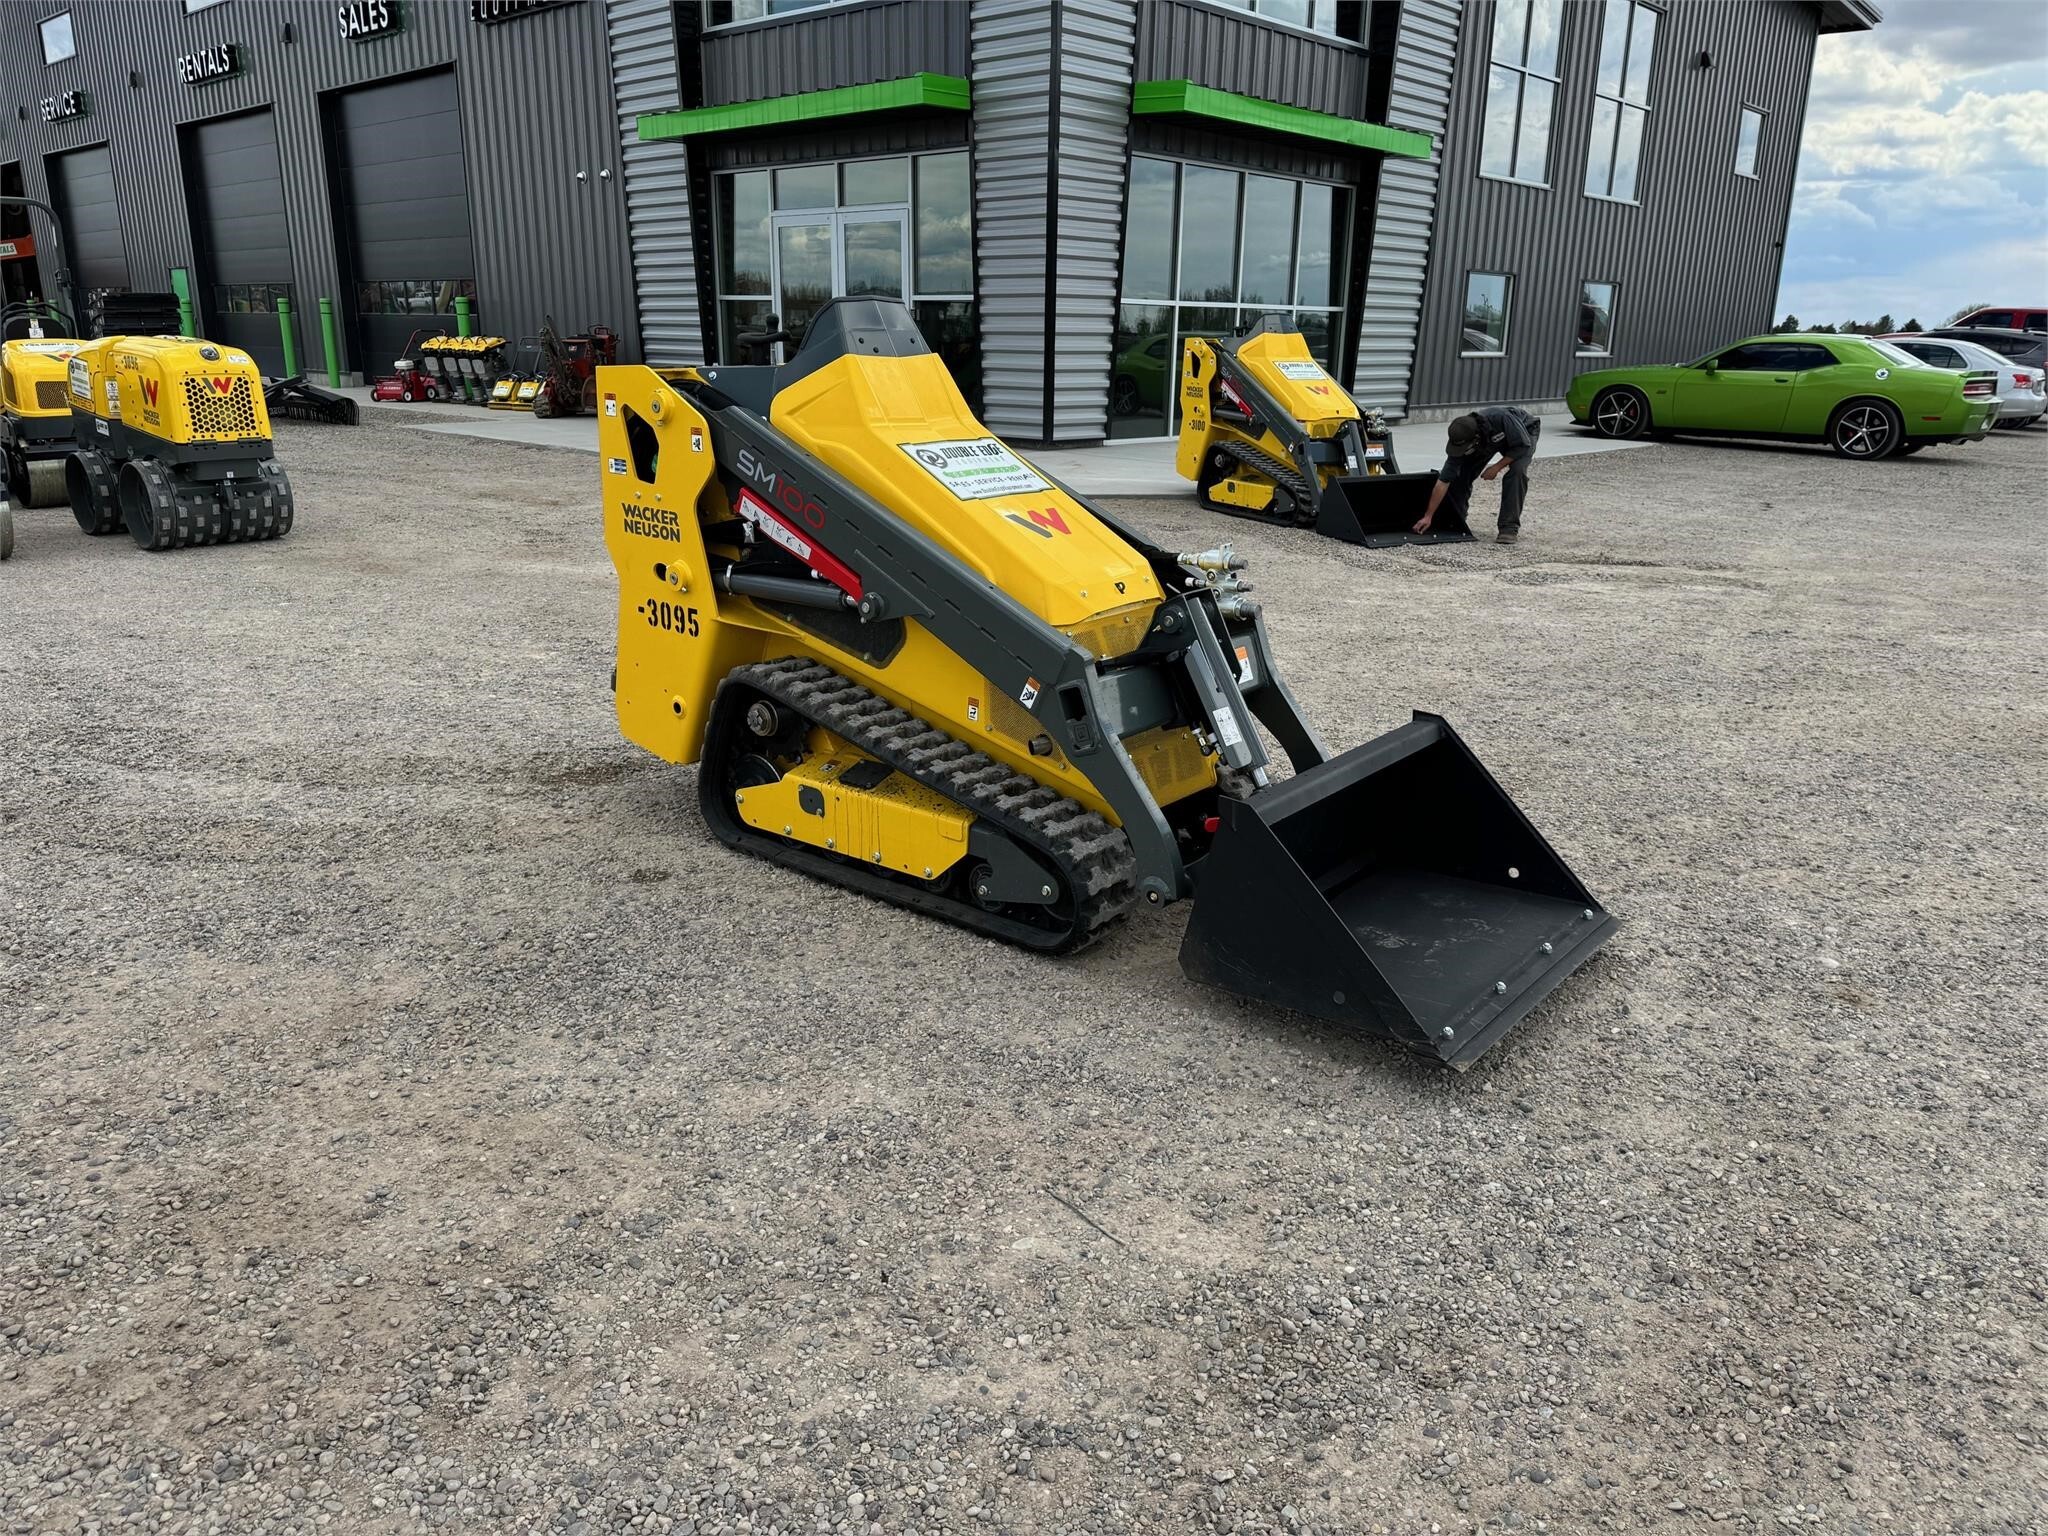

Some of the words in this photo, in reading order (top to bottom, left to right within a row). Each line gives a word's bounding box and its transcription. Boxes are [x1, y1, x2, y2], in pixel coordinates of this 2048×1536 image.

[339, 0, 388, 38] SALES
[178, 43, 230, 84] RENTALS
[40, 91, 76, 121] SERVICE
[940, 446, 980, 459] DOUBLE
[976, 444, 1003, 456] EDGE
[736, 449, 825, 529] SM100
[622, 502, 679, 527] WACKER
[624, 518, 680, 543] NEUSON
[638, 598, 700, 637] -3095
